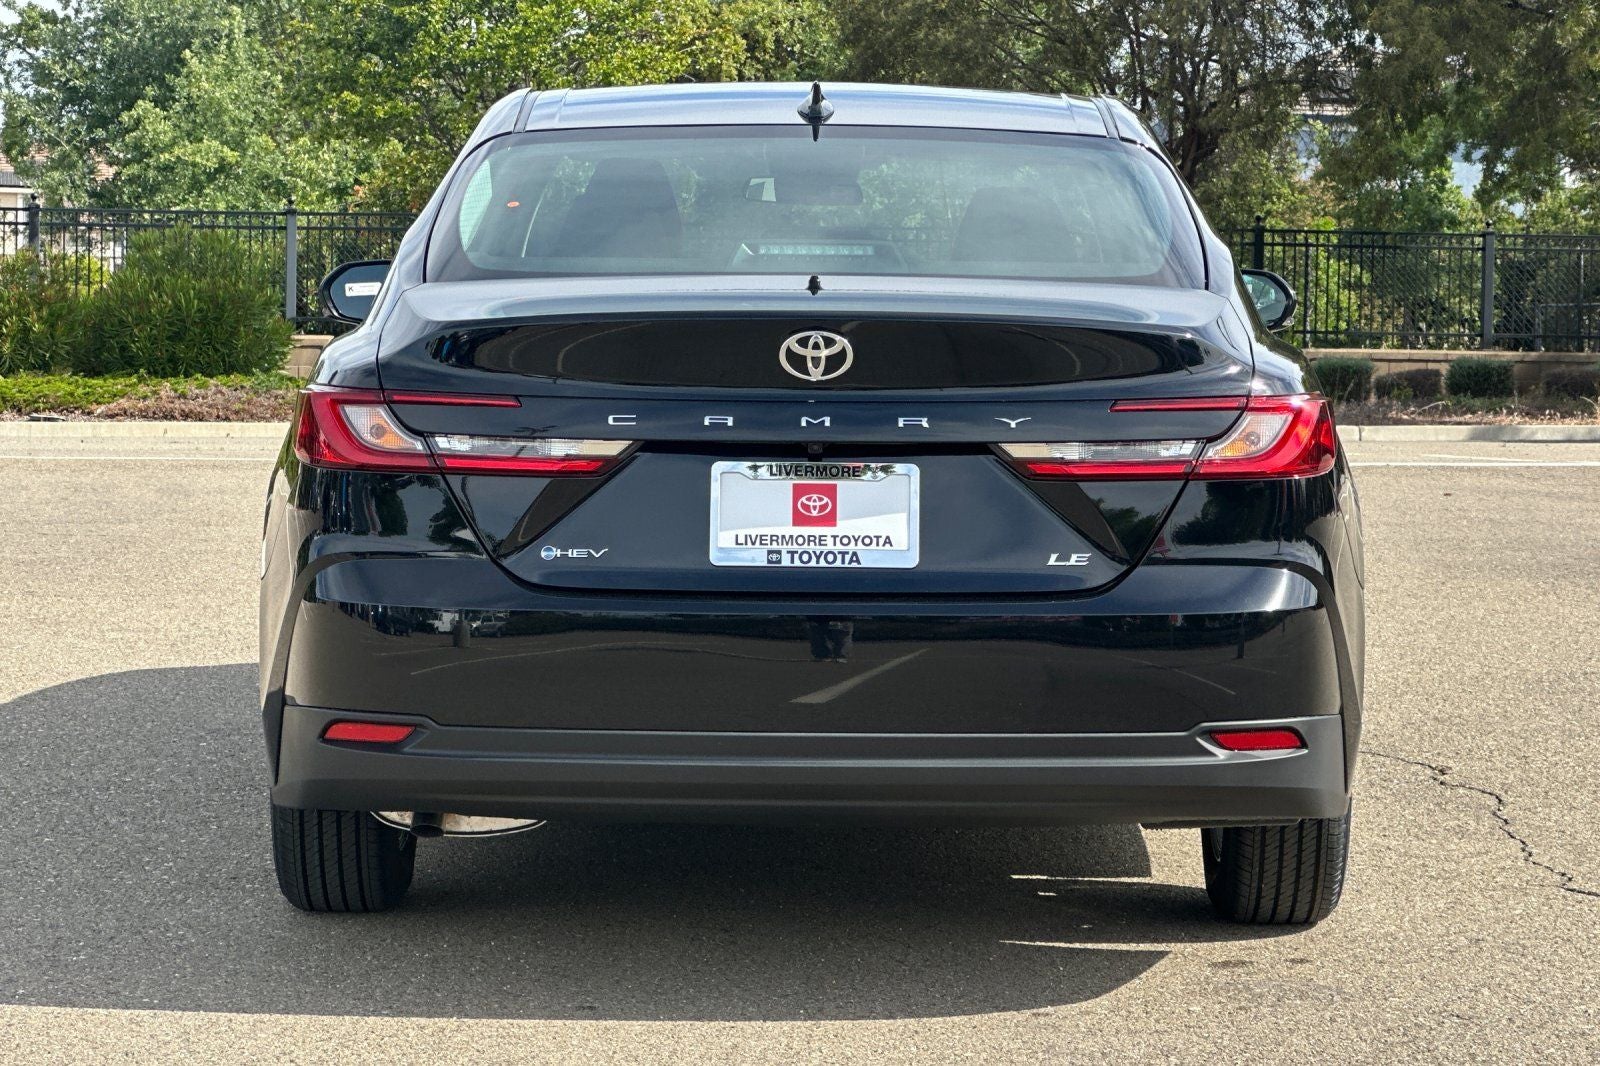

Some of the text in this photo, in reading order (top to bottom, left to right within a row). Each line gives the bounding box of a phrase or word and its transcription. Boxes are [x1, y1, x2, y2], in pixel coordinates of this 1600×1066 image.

[607, 415, 1032, 428] CAMRY
[769, 465, 861, 478] LIVERMORE
[735, 534, 893, 547] LIVERMORE TOYOTA
[787, 550, 861, 565] TOYOTA
[1046, 553, 1092, 566] LE
